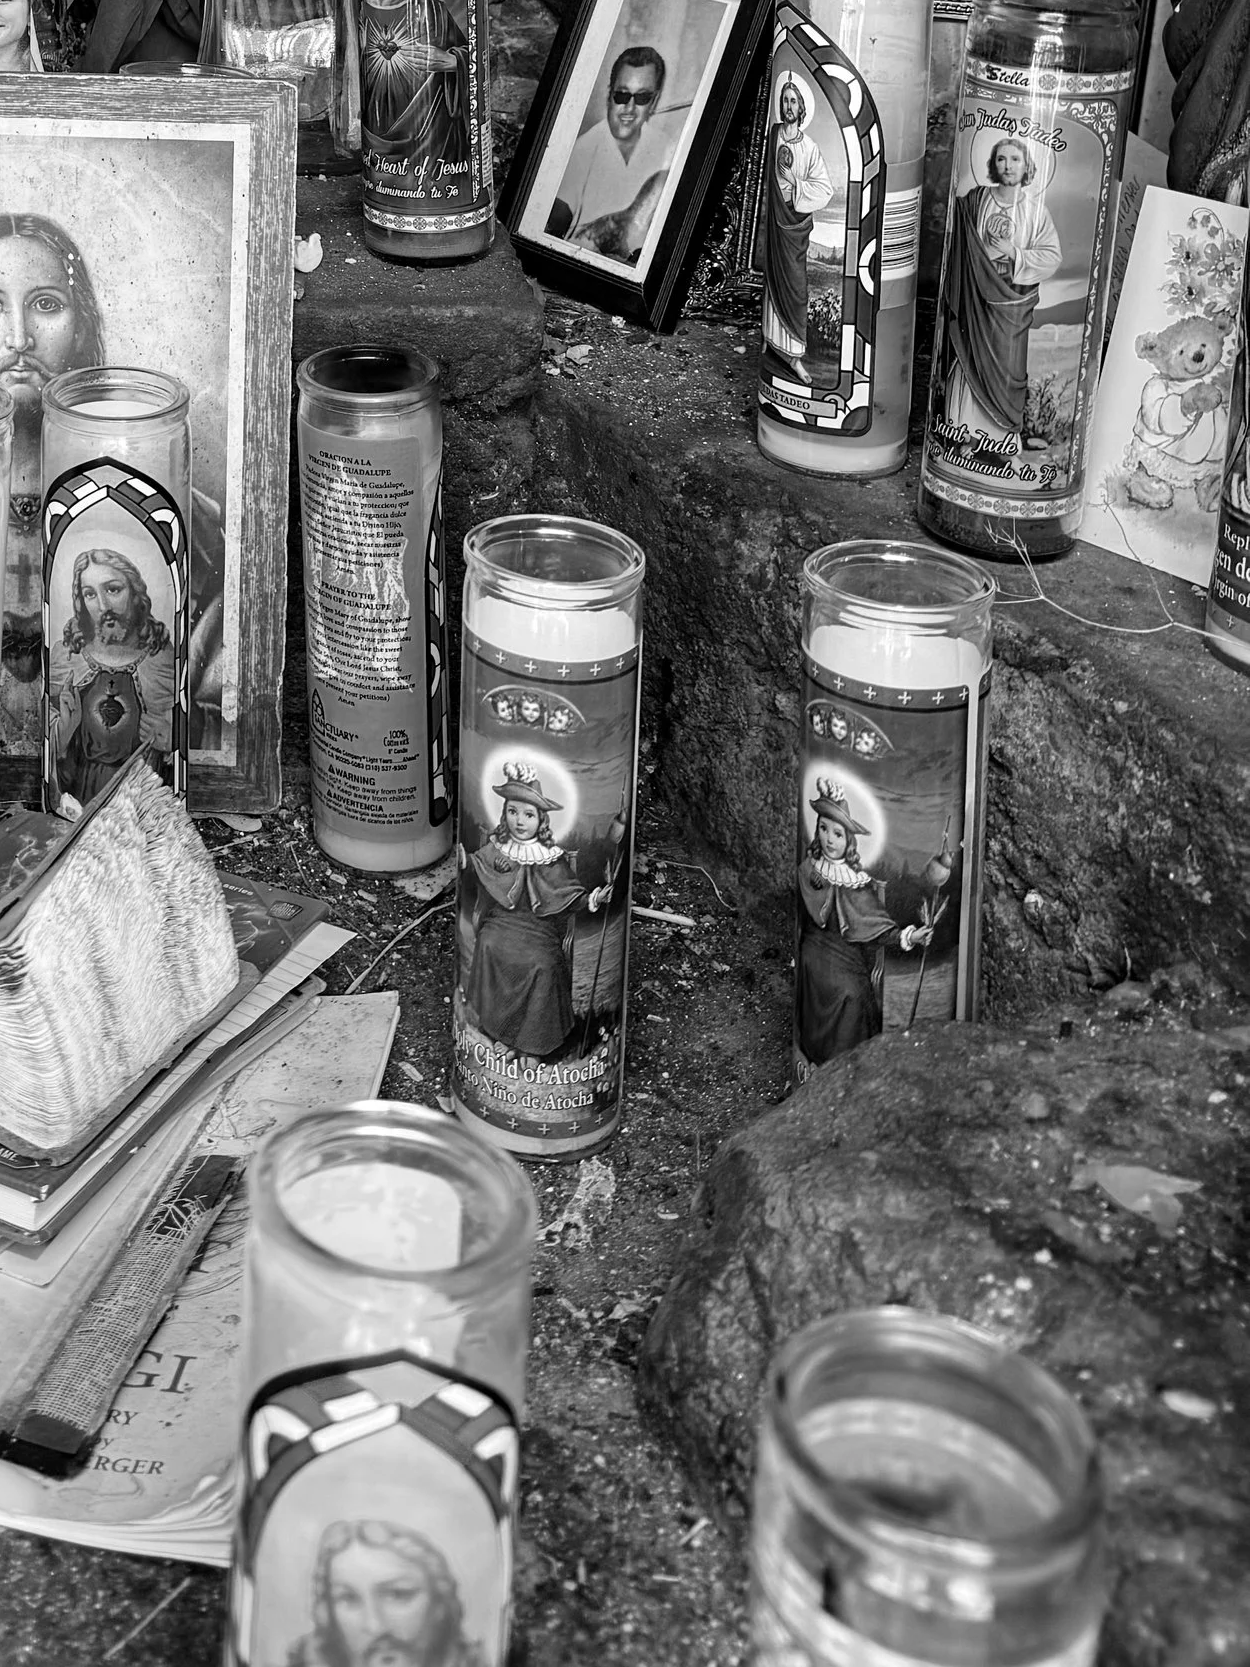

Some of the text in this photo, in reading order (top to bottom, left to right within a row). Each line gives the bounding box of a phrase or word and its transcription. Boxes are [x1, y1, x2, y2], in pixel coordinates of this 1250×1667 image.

[985, 64, 1030, 87] Stella
[977, 108, 1017, 137] Judas
[1019, 118, 1067, 152] Tadeo
[374, 153, 469, 185] Heart of Jesus
[375, 180, 426, 199] iluminando
[431, 186, 442, 199] tu
[446, 185, 459, 199] Fe
[779, 394, 810, 410] TADEO
[932, 414, 1018, 456] Saint Jude
[343, 467, 391, 476] GUADALUPE
[943, 446, 1057, 484] iluminando tu Fe
[1223, 523, 1250, 551] Repl
[343, 599, 391, 611] GUADALUPE
[389, 730, 406, 739] 100%
[335, 768, 376, 786] WARNING
[397, 786, 417, 794] things
[333, 793, 384, 812] ADVERTENCIA
[474, 1043, 519, 1080] Child
[523, 1063, 546, 1084] of
[547, 1059, 607, 1085] Atocha
[481, 1075, 594, 1110] Niño de Atocha
[120, 1348, 198, 1394] GI
[107, 1408, 139, 1426] RY
[94, 1456, 165, 1475] RGER
